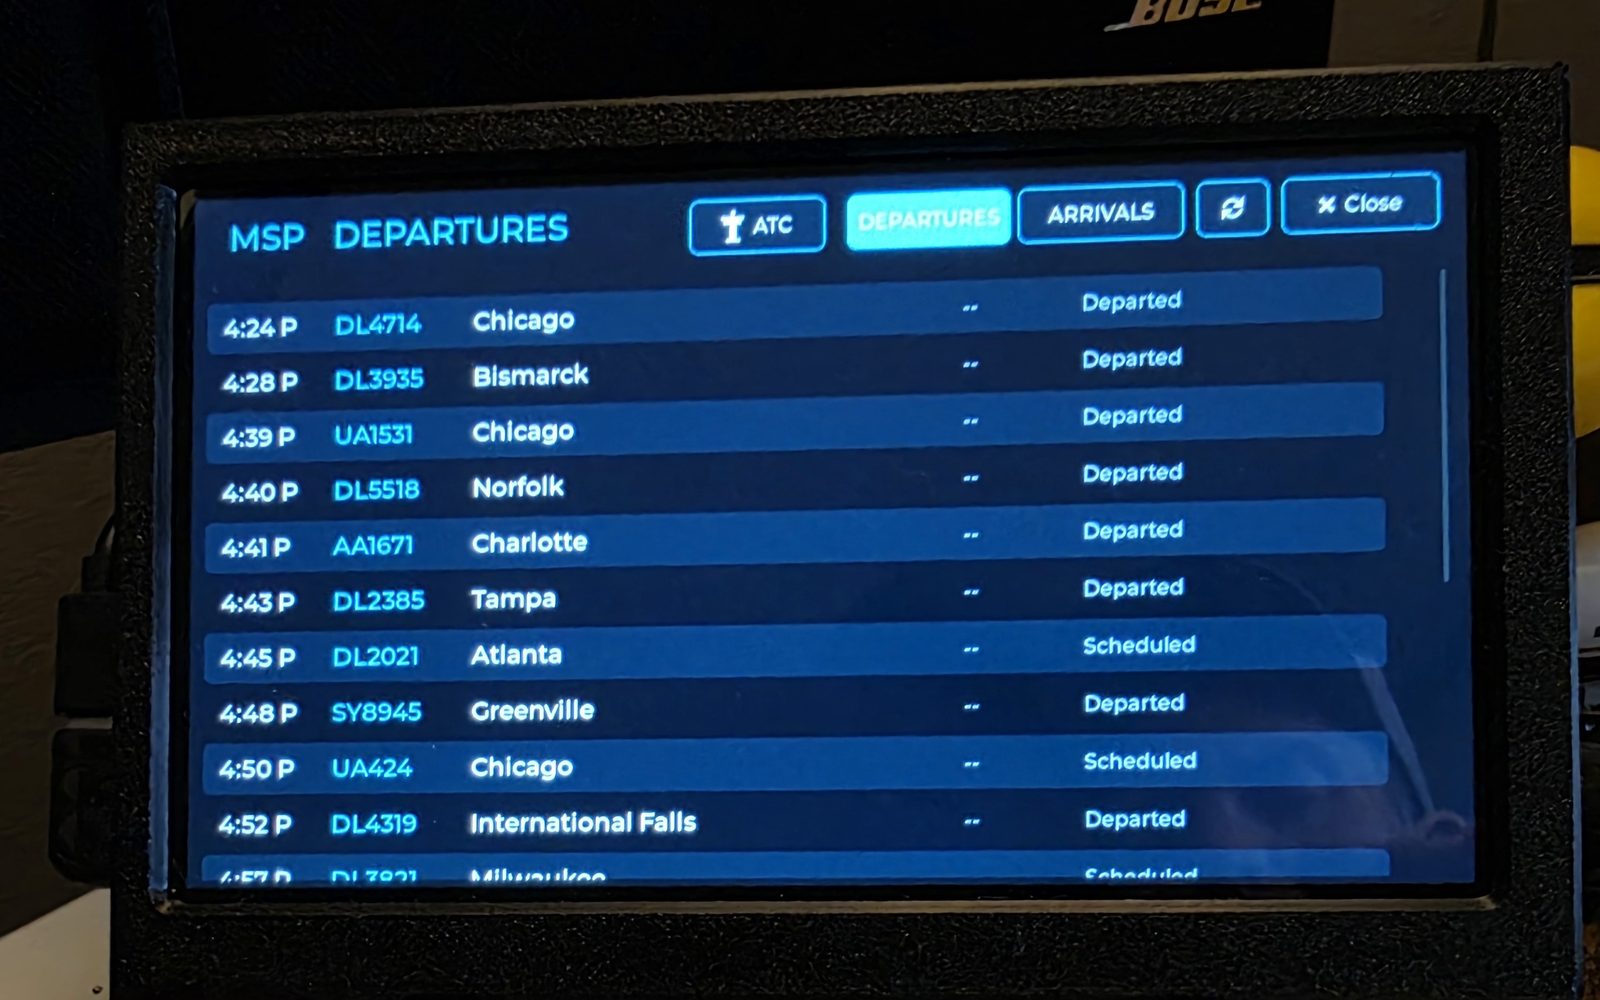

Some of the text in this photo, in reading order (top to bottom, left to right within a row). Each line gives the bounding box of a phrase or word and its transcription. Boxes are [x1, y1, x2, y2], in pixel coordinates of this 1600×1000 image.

[857, 207, 1002, 233] DEPARTURES
[1046, 200, 1156, 225] ARRIVALS
[1343, 192, 1403, 215] Close
[229, 213, 570, 254] MSP DEPARTURES
[752, 213, 794, 236] ATC
[223, 317, 275, 339] 4:24
[281, 316, 298, 337] P
[335, 313, 422, 336] DL4714
[472, 308, 575, 335] Chicago
[1082, 290, 1182, 315] Departed
[222, 372, 276, 394] 4:28
[281, 371, 299, 392] P
[335, 368, 424, 391] DL3935
[472, 361, 589, 388] Bismarck
[1082, 346, 1183, 372] Departed
[222, 427, 273, 449] 4:39
[278, 426, 296, 447] P
[334, 423, 413, 446] UA1531
[471, 419, 575, 446] Chicago
[1083, 404, 1183, 429] Departed
[221, 482, 276, 504] 4:40
[281, 481, 299, 502] P
[334, 479, 420, 501] DL5518
[472, 474, 565, 499] Norfolk
[1083, 462, 1184, 486] Departed
[220, 538, 267, 558] 4:41
[274, 537, 292, 556] P
[332, 534, 413, 556] AA1671
[471, 530, 589, 554] Charlotte
[1083, 519, 1184, 544] Departed
[220, 592, 273, 614] 4:43
[278, 591, 296, 612] P
[333, 589, 425, 612] DL2385
[470, 588, 557, 614] Tampa
[1083, 577, 1184, 601] Departed
[219, 648, 273, 669] 4:45
[279, 647, 296, 667] P
[333, 645, 418, 668] DL2021
[470, 643, 563, 666] Atlanta
[1083, 634, 1196, 656] Scheduled
[219, 703, 275, 724] 4:48
[281, 702, 298, 722] P
[331, 701, 422, 723] SY8945
[469, 698, 596, 722] Greenville
[1084, 692, 1185, 716] Departed
[218, 759, 272, 780] 4:50
[278, 758, 296, 778] P
[332, 757, 414, 779] UA424
[469, 755, 574, 782] Chicago
[1083, 751, 1197, 771] Scheduled
[218, 815, 269, 836] 4:52
[275, 814, 293, 834] P
[331, 813, 417, 835] DL4319
[470, 810, 633, 834] International
[639, 810, 697, 832] Falls
[1085, 809, 1186, 832] Departed
